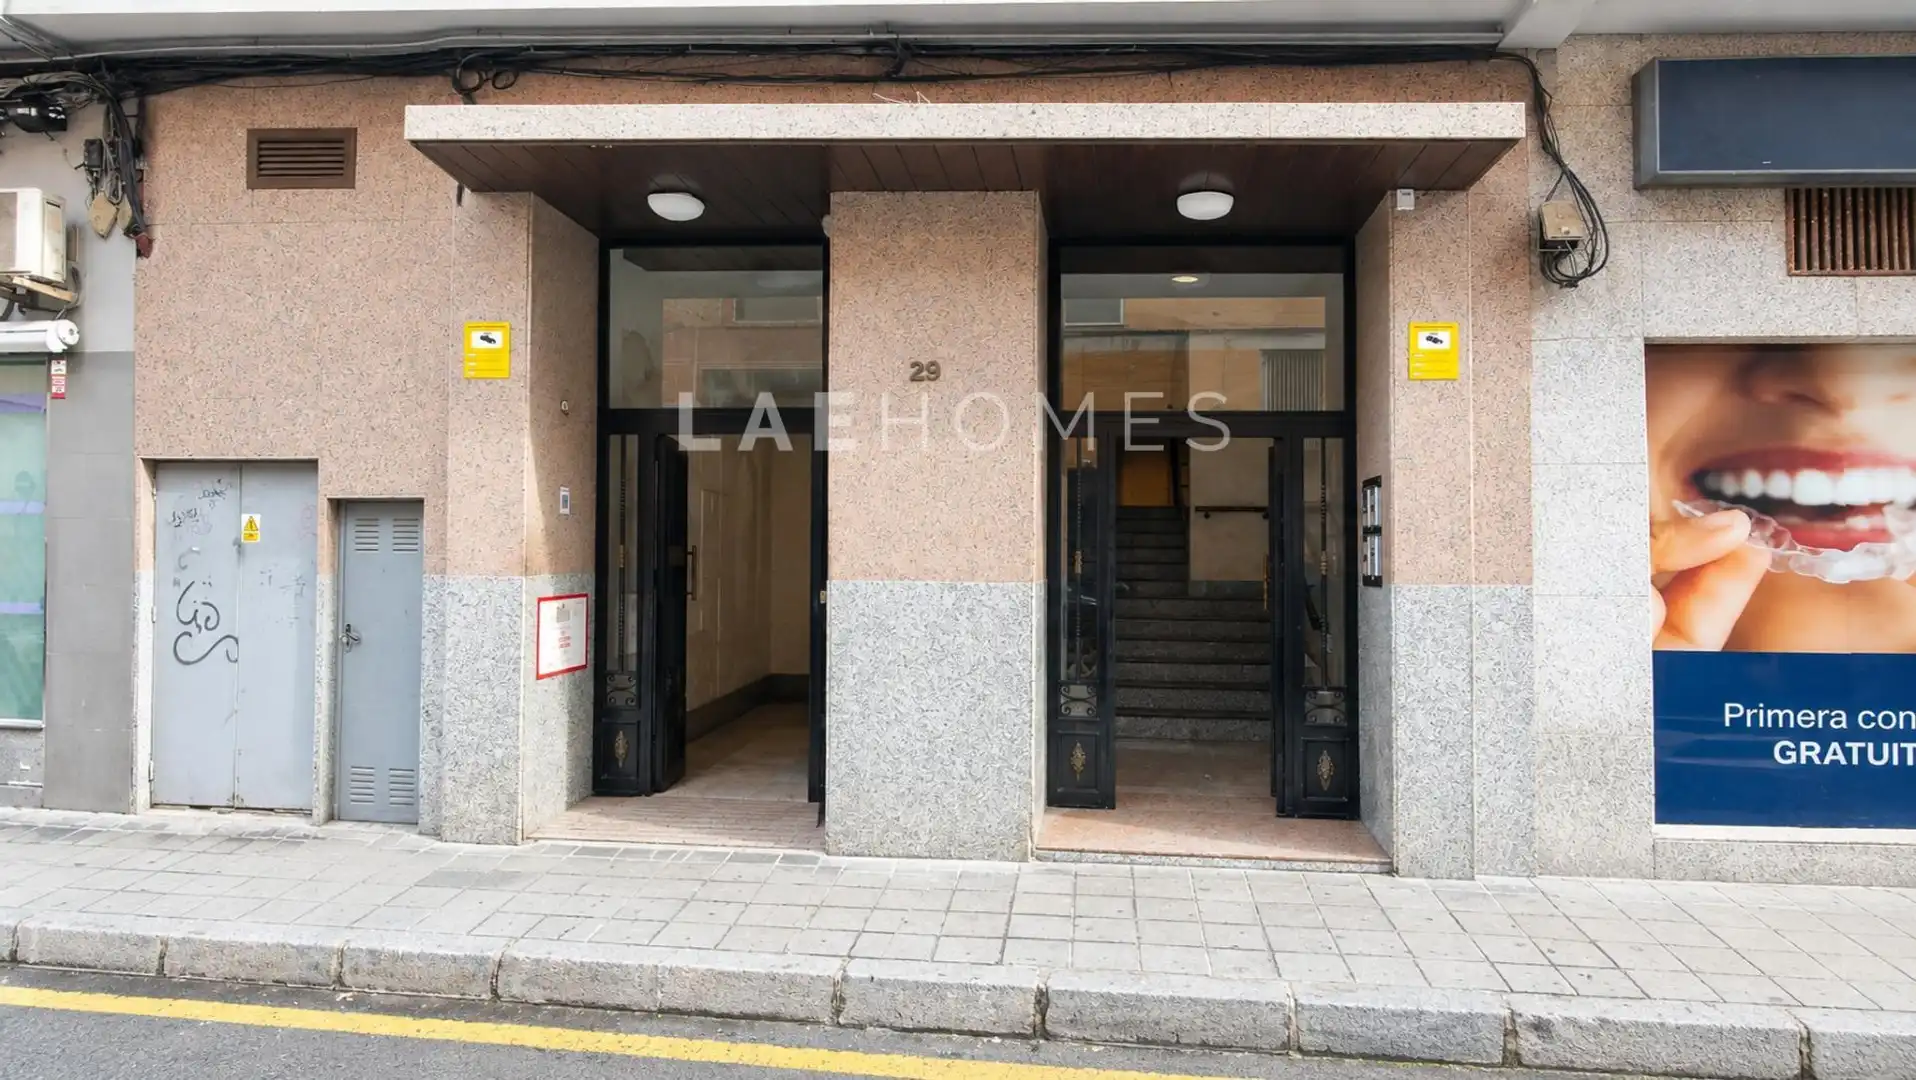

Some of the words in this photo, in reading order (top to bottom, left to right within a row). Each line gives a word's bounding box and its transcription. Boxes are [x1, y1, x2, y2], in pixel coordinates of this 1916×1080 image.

[910, 360, 941, 381] 29
[1724, 702, 1848, 729] Primera
[1773, 740, 1916, 766] GRATUIT
